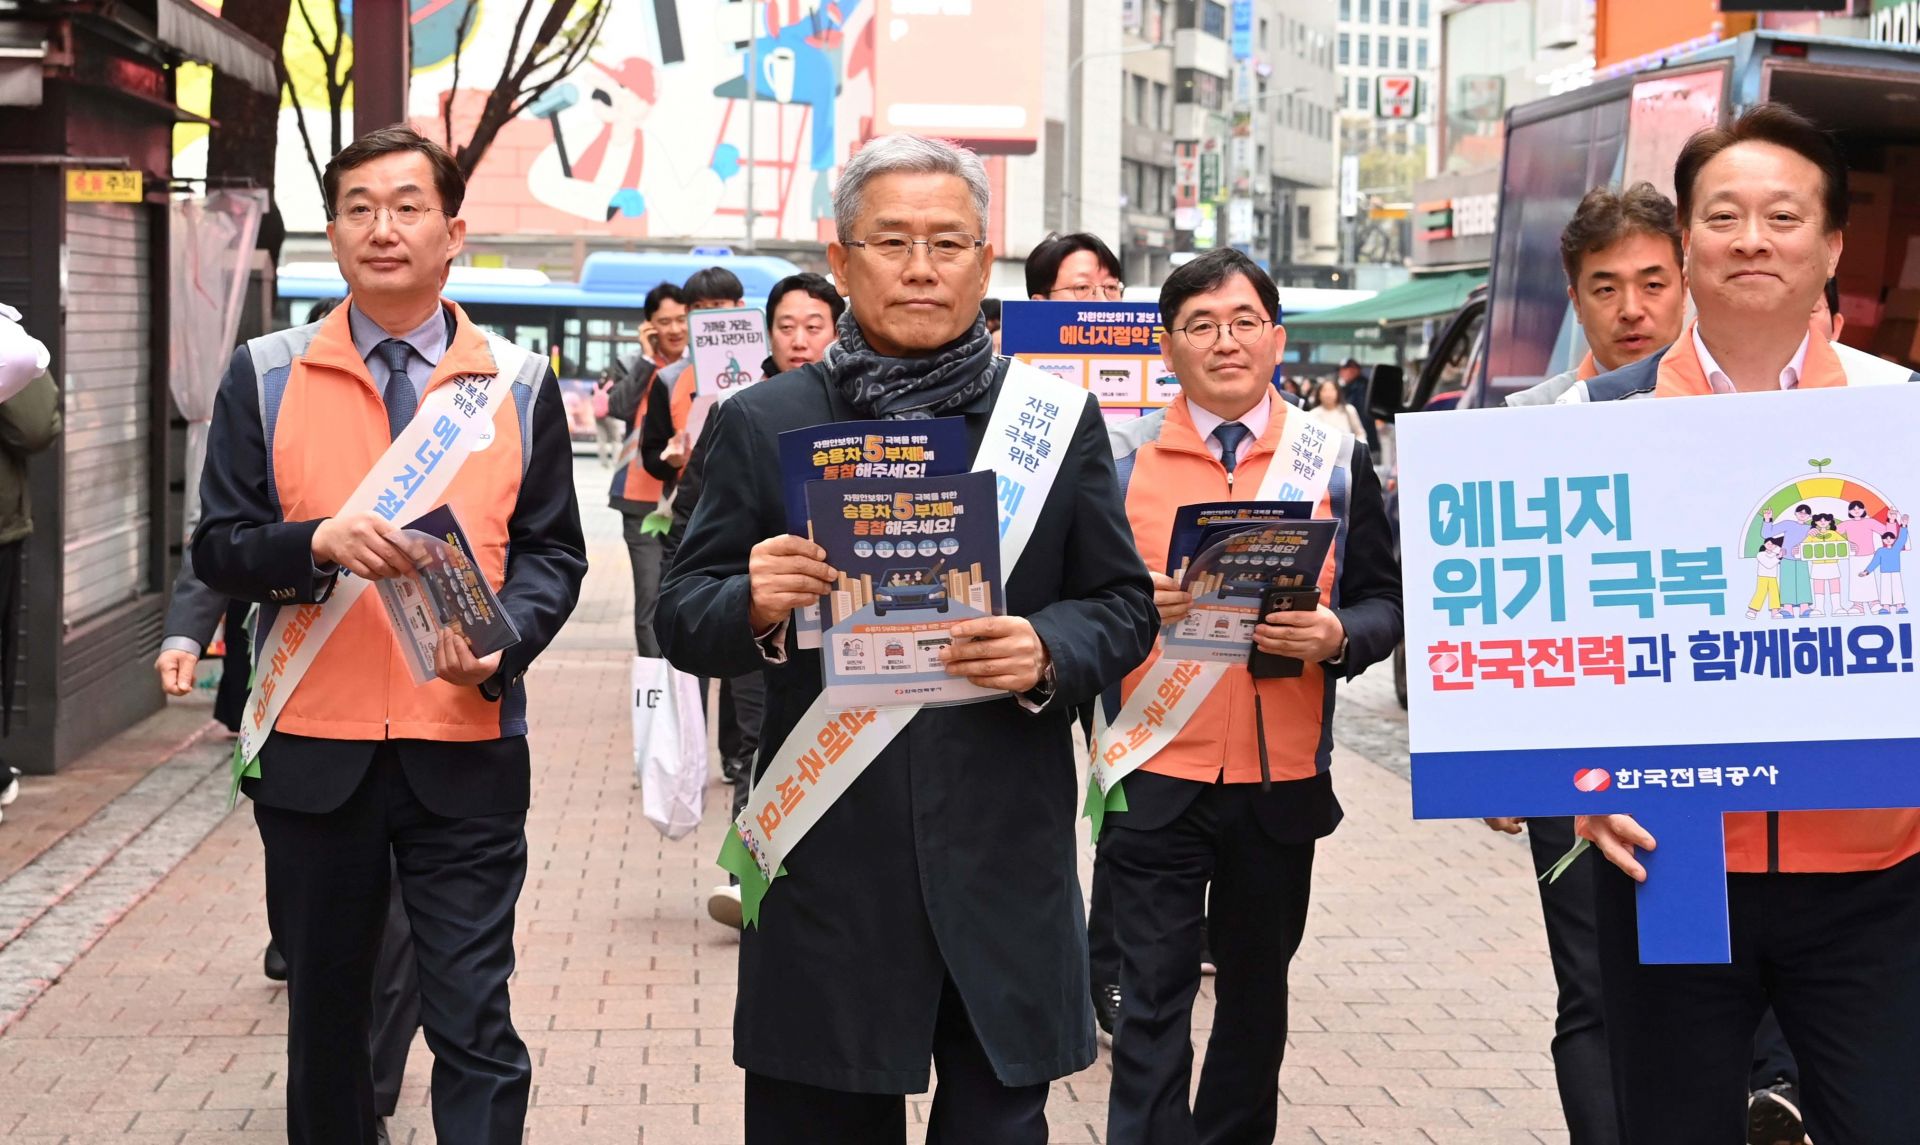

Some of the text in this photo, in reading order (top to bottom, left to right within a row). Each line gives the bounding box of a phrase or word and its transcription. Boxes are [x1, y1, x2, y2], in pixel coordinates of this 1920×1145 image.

[1077, 312, 1134, 323] 자원안보위기
[1136, 312, 1156, 323] 경보
[721, 333, 745, 345] 자전거
[747, 332, 763, 344] 타기
[1060, 325, 1151, 346] 에너지절약
[453, 393, 477, 418] 위한
[1025, 396, 1060, 420] 자원
[1018, 411, 1051, 437] 위기
[1304, 423, 1327, 442] 자원
[813, 435, 928, 449] 자원안보위기 극복을 위한
[1005, 424, 1052, 459] 극복을
[1300, 433, 1323, 454] 위기
[812, 447, 861, 466] 승용차
[1008, 446, 1040, 474] 위한
[1291, 442, 1324, 470] 극복을
[823, 463, 926, 480] 동참해주세요!
[1293, 460, 1315, 480] 위한
[843, 490, 957, 502] 자원안보위기 극복을 위한
[843, 503, 891, 519] 승용차
[1428, 473, 1632, 548] 에너지
[854, 518, 956, 535] 동참해주세요!
[1433, 546, 1727, 626] 위기 극복
[1427, 623, 1913, 691] 한국전력과 함께해요!
[1615, 764, 1778, 789] 한국전력공사
